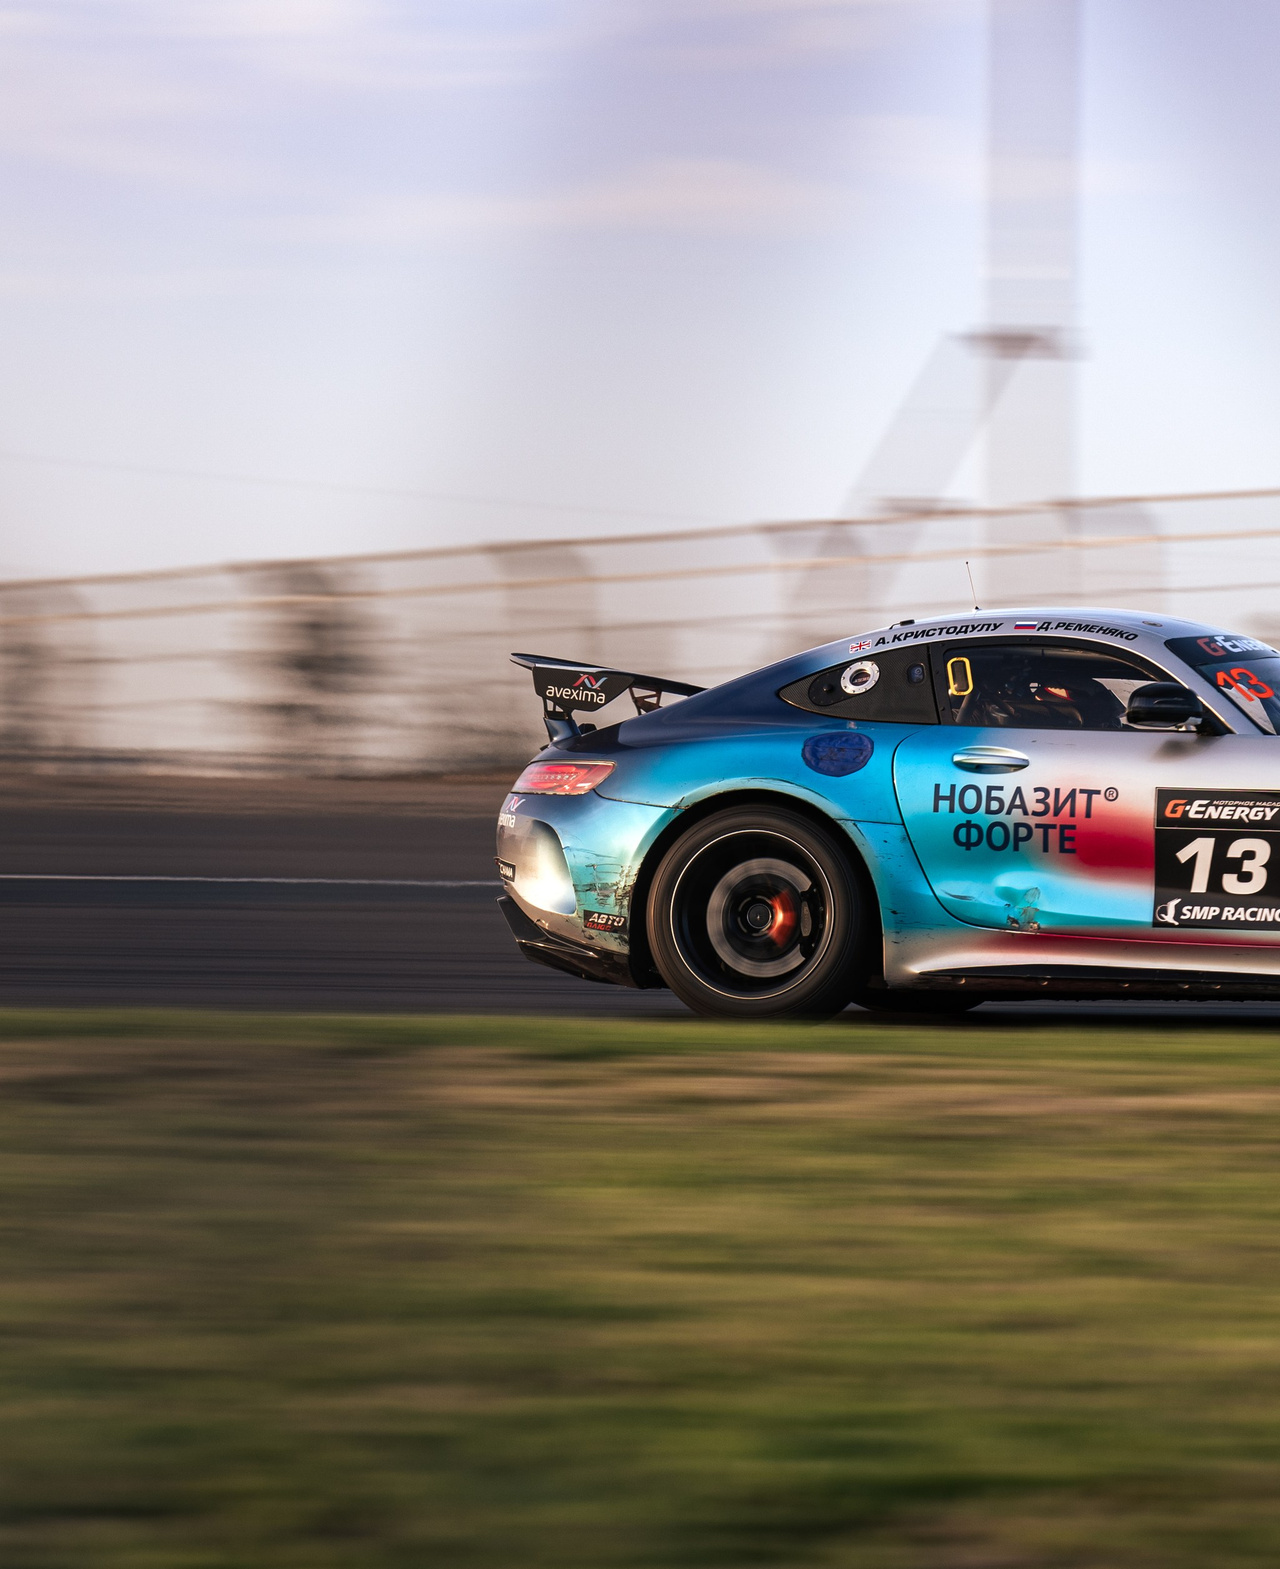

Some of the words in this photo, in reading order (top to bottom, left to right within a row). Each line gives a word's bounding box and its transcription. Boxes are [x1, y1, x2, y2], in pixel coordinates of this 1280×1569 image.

[874, 622, 1004, 647] А.КРИСТОДУЛУ
[1037, 621, 1139, 641] Д.РЕМЕНЯКО
[546, 685, 606, 704] avexima
[1216, 667, 1275, 702] 13
[953, 820, 1077, 854] ФОРТЕ
[1175, 837, 1271, 895] 13
[588, 912, 625, 926] АВТО
[1180, 906, 1220, 920] SMP
